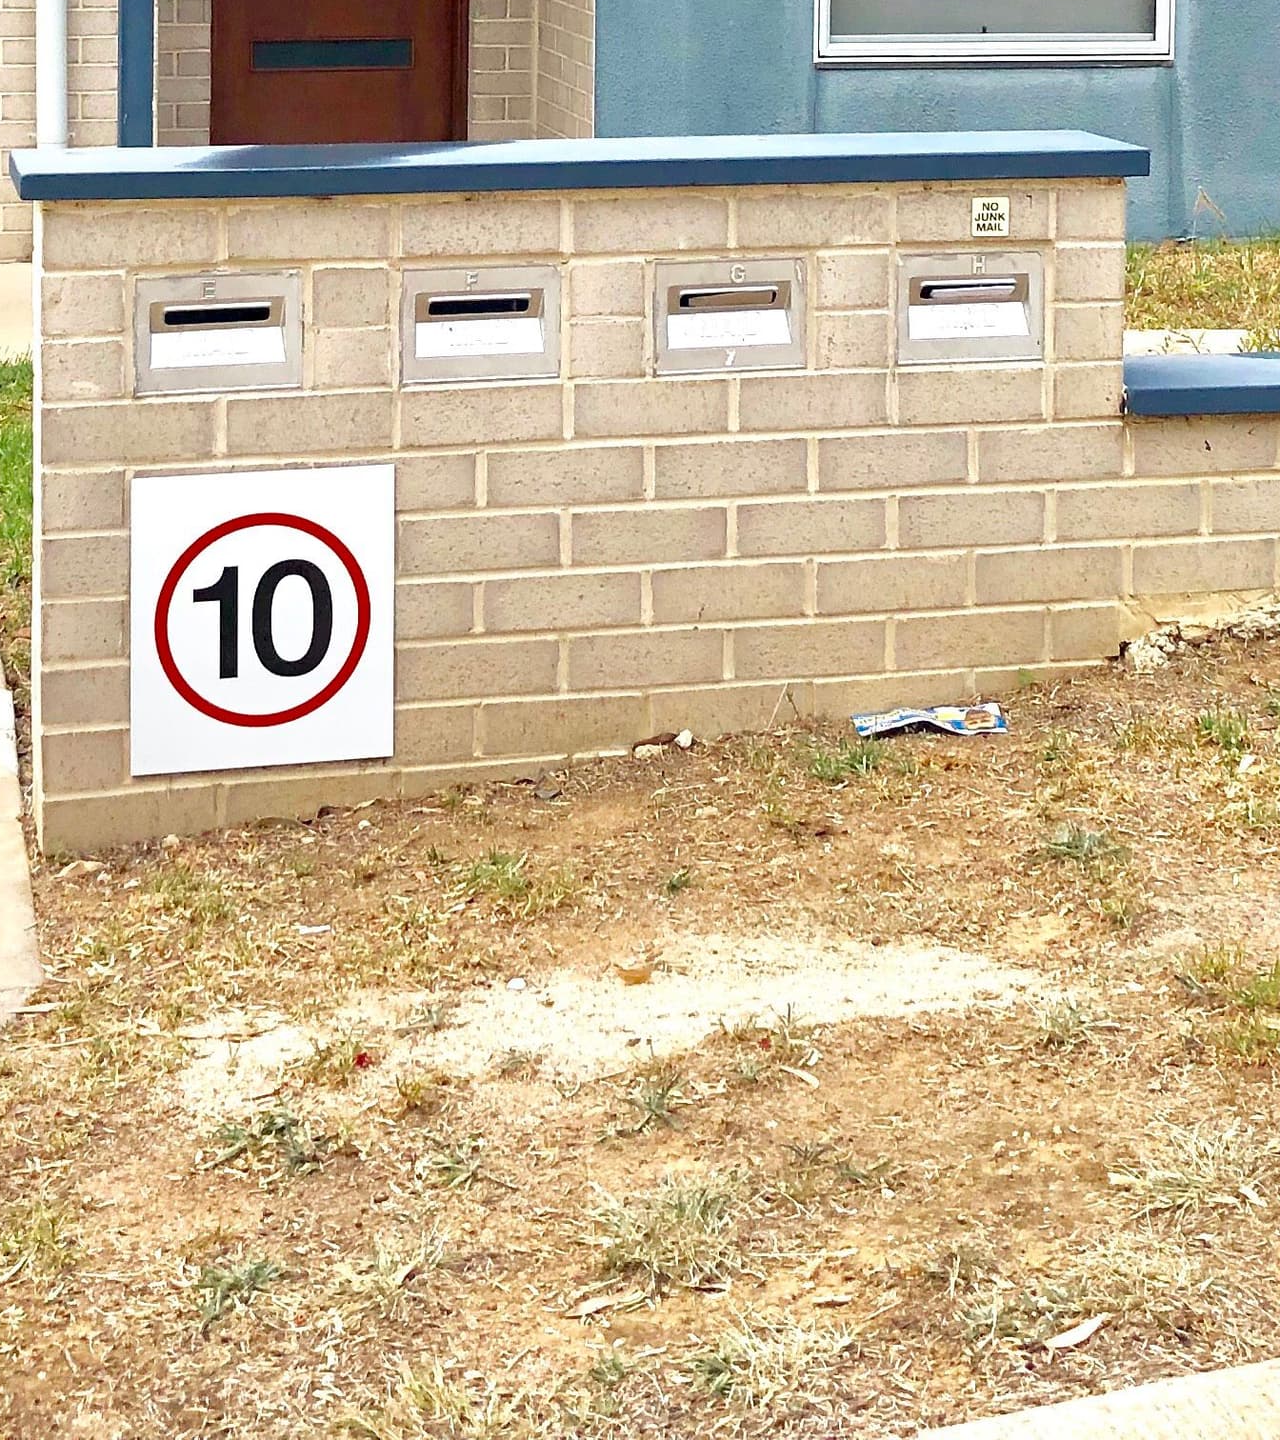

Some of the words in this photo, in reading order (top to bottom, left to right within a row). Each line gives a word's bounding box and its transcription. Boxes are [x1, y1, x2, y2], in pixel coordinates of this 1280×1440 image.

[982, 202, 999, 211] NO
[974, 212, 1006, 222] JUNK
[976, 222, 1004, 232] MAIL
[730, 263, 747, 284] G
[972, 254, 986, 274] H
[202, 279, 217, 299] E
[465, 271, 479, 291] F
[192, 558, 334, 679] 10
